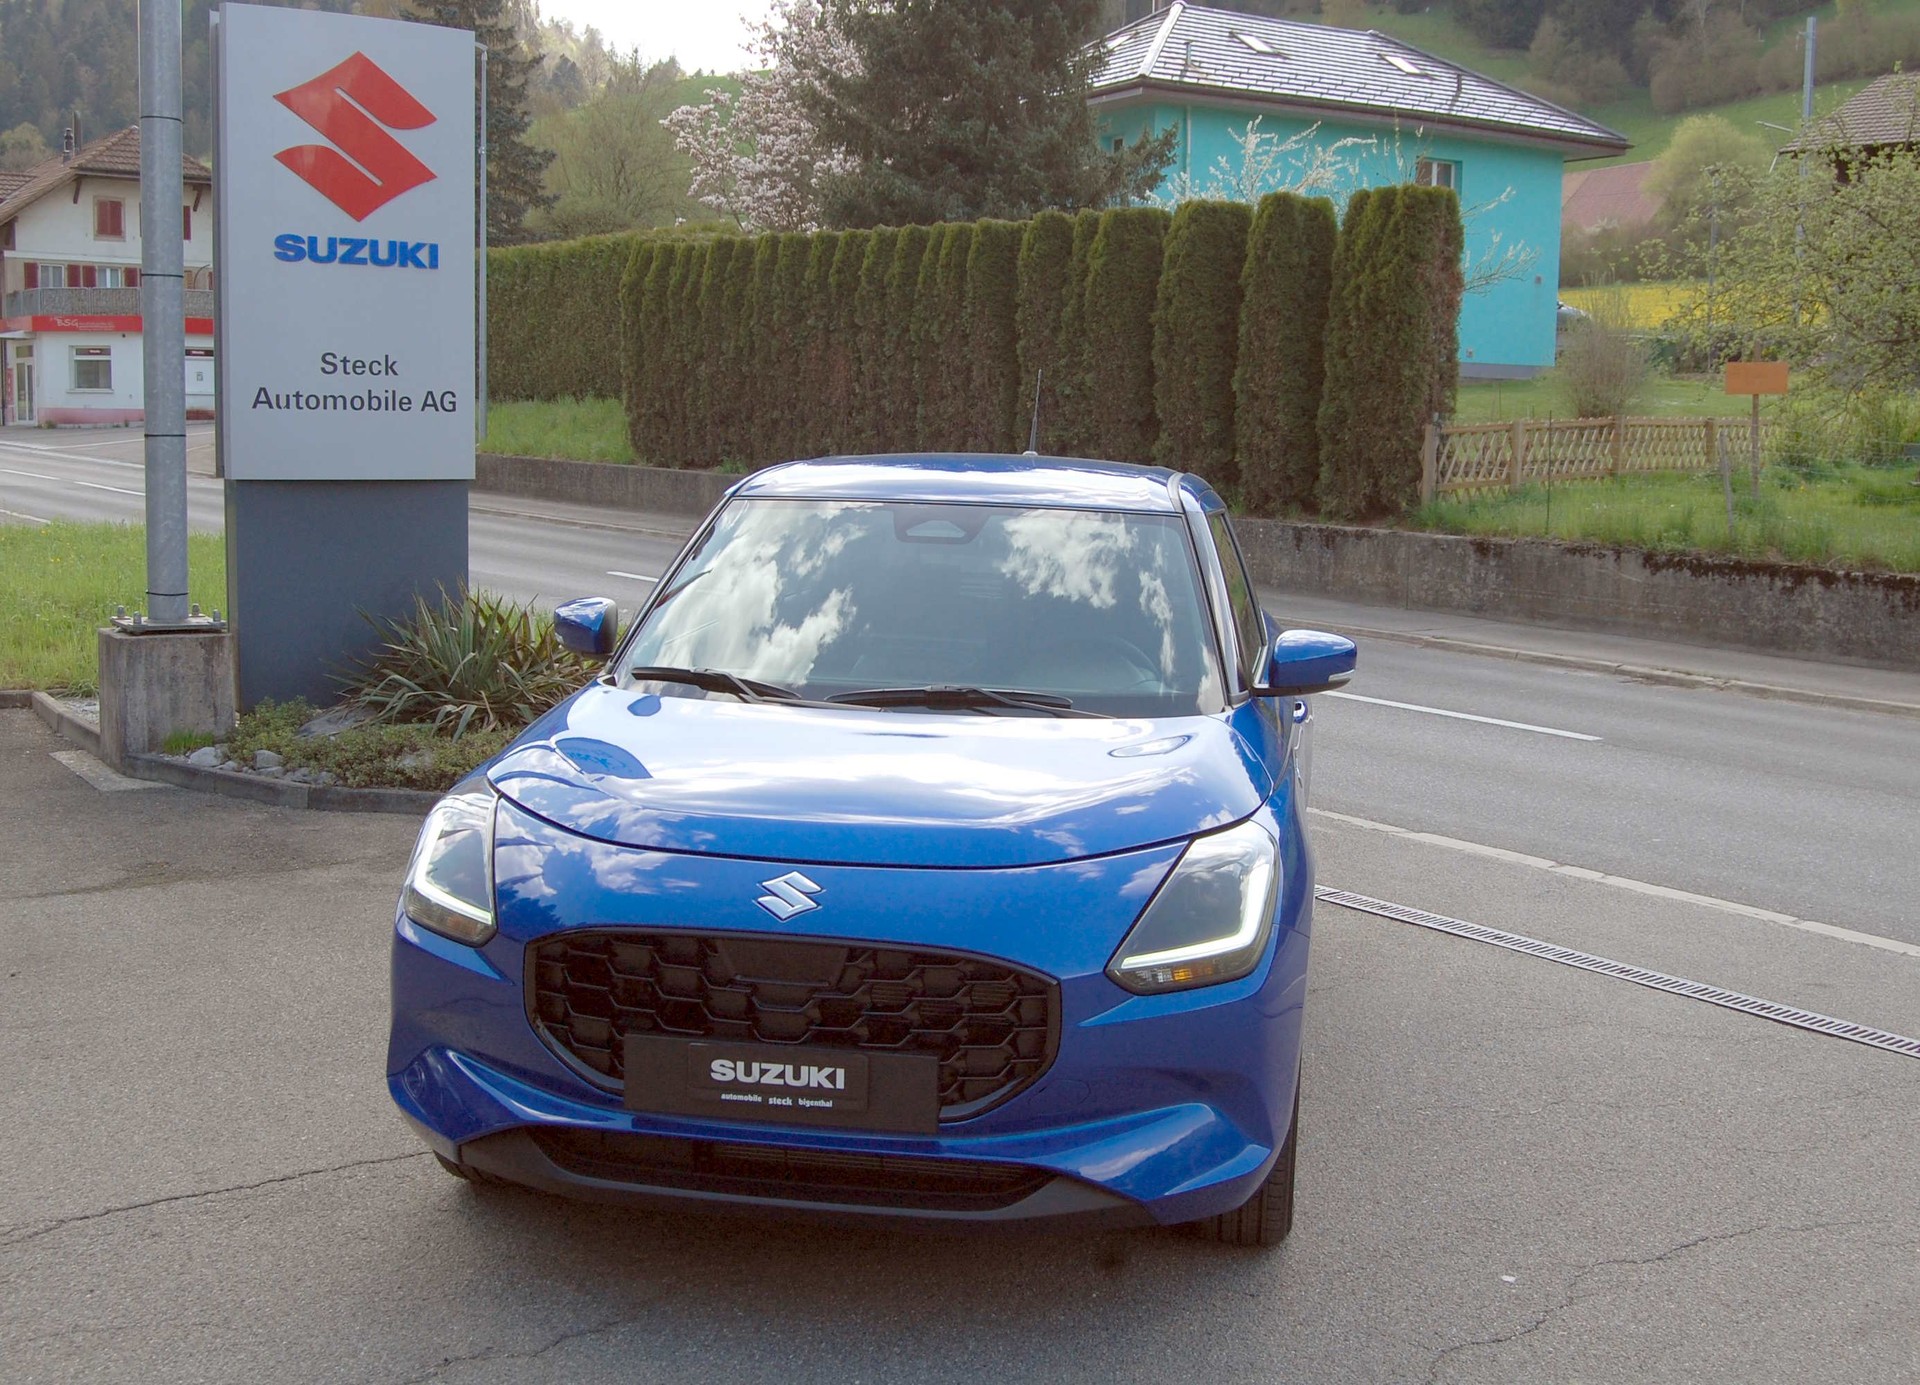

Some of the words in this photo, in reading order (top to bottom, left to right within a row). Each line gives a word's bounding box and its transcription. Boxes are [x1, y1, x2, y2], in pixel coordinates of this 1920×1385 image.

[274, 233, 439, 270] SUZUKI
[320, 352, 399, 376] Steck
[251, 386, 413, 411] Automobile
[420, 390, 457, 412] AG
[710, 1058, 845, 1090] SUZUKI
[720, 1092, 762, 1103] automobile
[768, 1096, 793, 1106] steck
[798, 1098, 833, 1108] bigenthal
